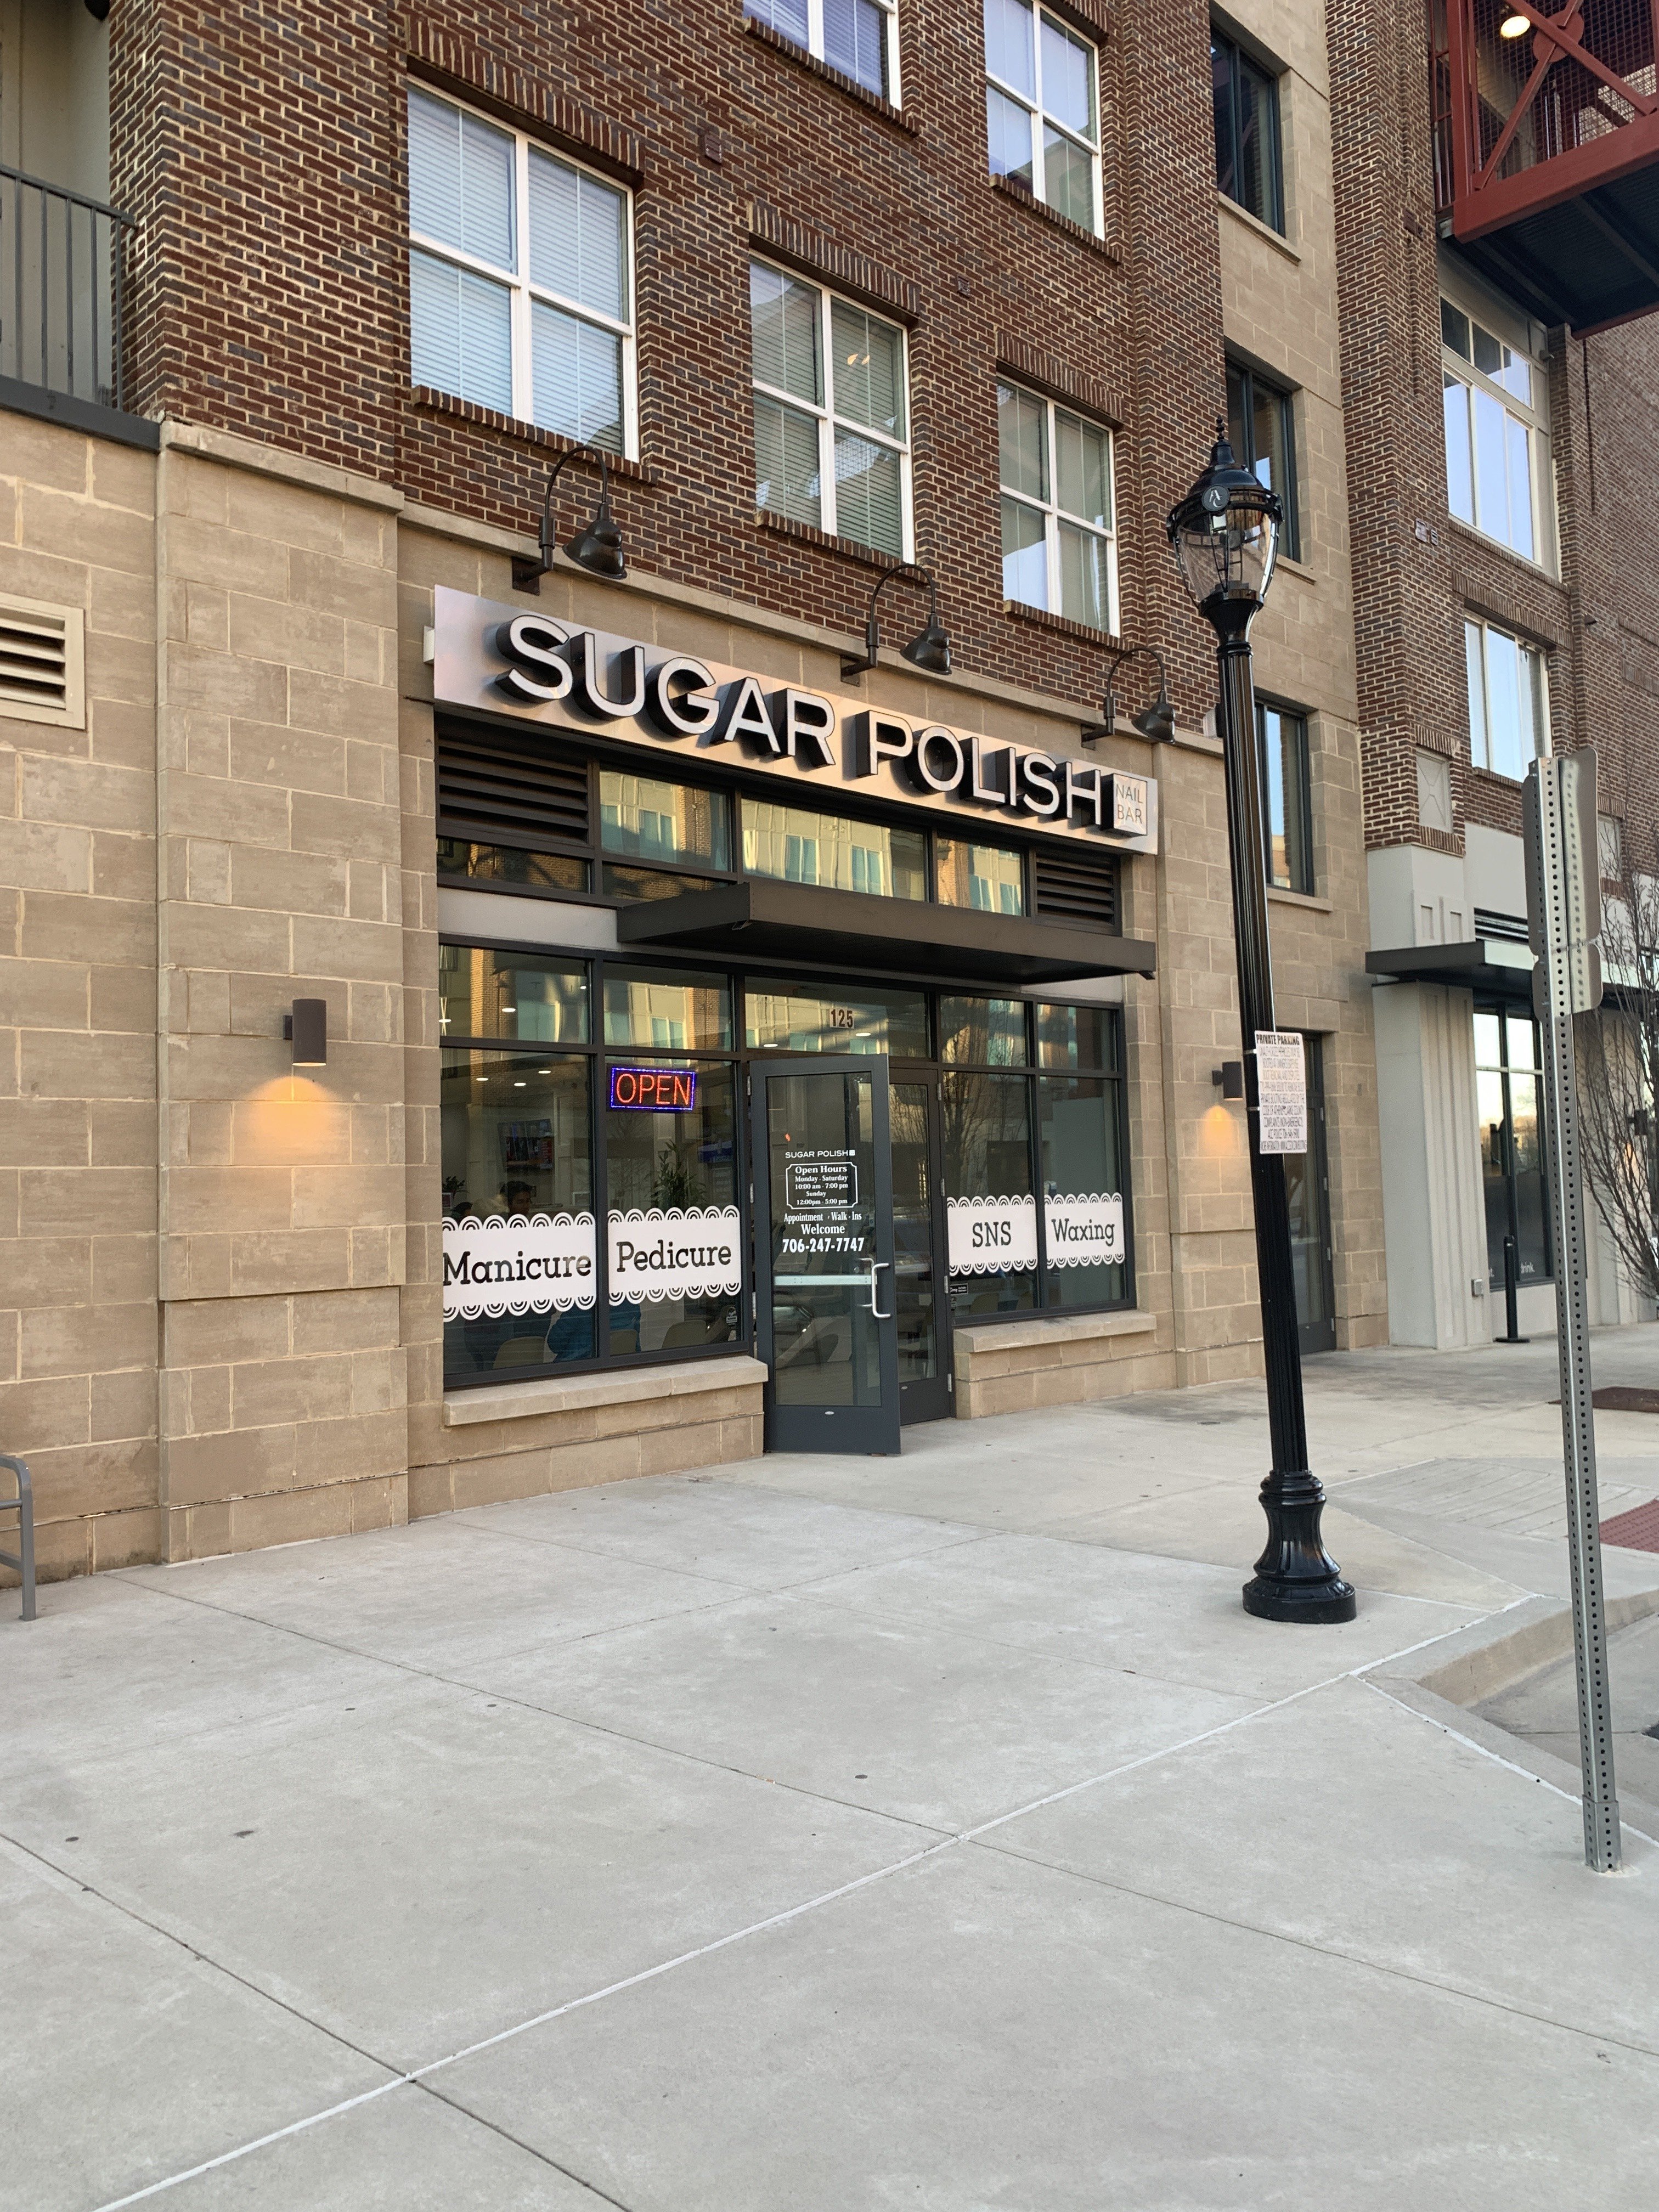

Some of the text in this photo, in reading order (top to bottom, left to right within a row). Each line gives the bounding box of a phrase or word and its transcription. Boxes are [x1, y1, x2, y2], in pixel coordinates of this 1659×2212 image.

[505, 613, 1102, 826] SUGAR POLISH
[1116, 783, 1143, 804] NAIL
[1117, 804, 1142, 823] BAR
[831, 1009, 853, 1028] 125
[1256, 1034, 1300, 1046] PRIVATE PARKING
[616, 1073, 691, 1105] OPEN
[795, 1165, 848, 1176] Open Hours
[784, 1212, 823, 1224] Appointment
[801, 1223, 845, 1235] Welcome
[972, 1221, 1012, 1248] SNS
[1051, 1217, 1115, 1247] Waxing
[782, 1237, 865, 1253] 706-247-7747
[616, 1239, 732, 1273] Pedicure
[443, 1250, 591, 1286] Manicure
